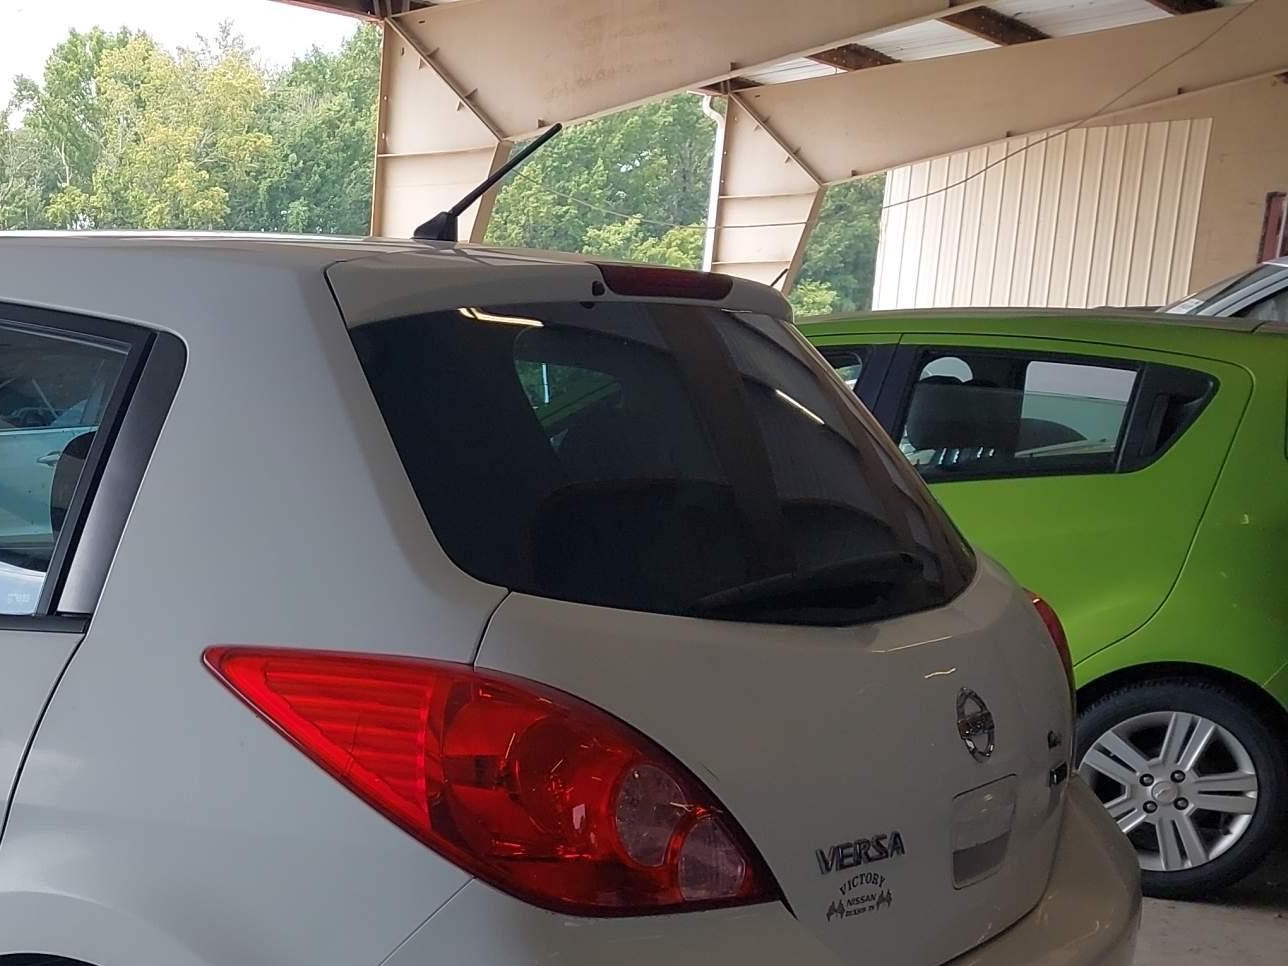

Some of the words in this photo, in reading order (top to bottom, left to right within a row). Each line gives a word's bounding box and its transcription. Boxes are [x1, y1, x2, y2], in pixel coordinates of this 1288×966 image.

[815, 831, 905, 875] VERSA
[839, 872, 886, 895] VICTORY
[846, 894, 878, 907] NISSAN
